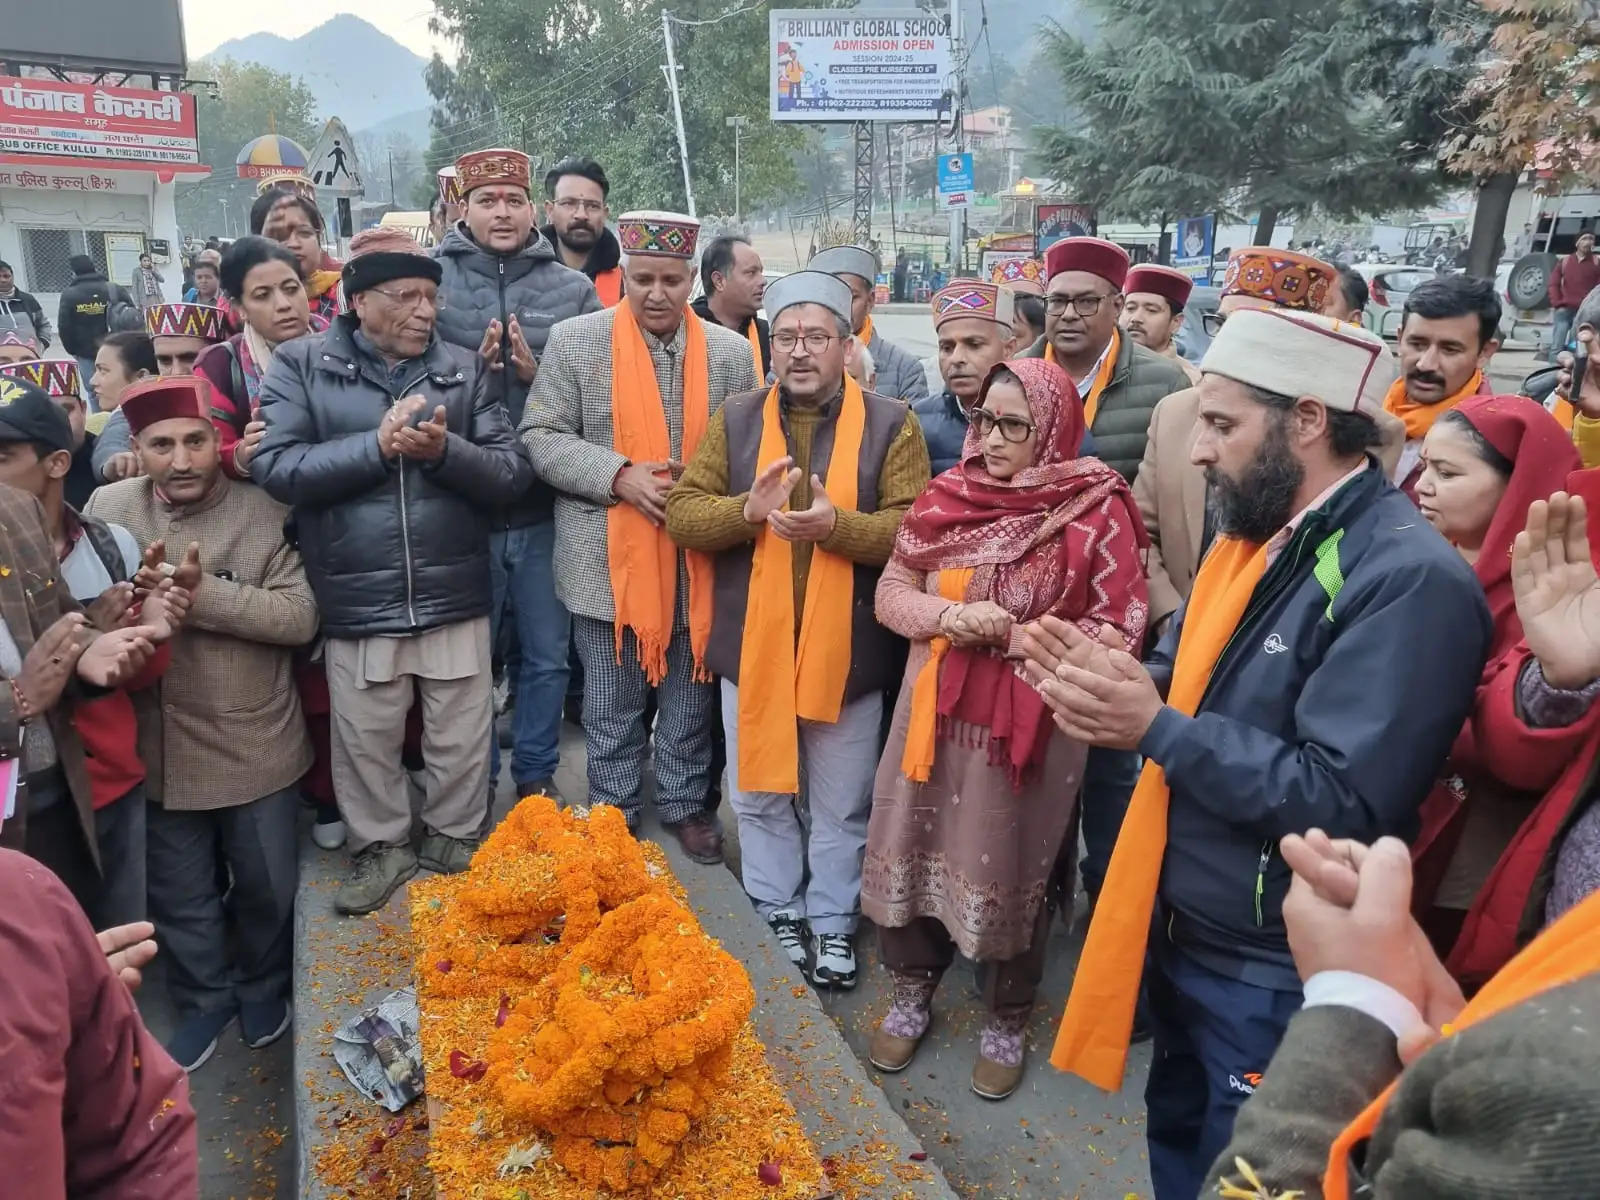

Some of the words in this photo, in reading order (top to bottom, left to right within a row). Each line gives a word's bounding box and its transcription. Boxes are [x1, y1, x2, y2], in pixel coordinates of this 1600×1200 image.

[788, 20, 850, 38] BRILLIANT
[853, 20, 900, 37] GLOBAL
[833, 39, 899, 51] ADMISSION
[902, 39, 935, 50] OPEN
[852, 55, 883, 63] SESSION
[885, 54, 914, 62] 2024-25
[0, 83, 86, 114] पंजाब
[93, 90, 182, 122] केसरी
[0, 139, 20, 149] SUB
[23, 140, 60, 152] OFFICE
[63, 143, 97, 154] KULLU
[16, 170, 48, 187] पुलिस
